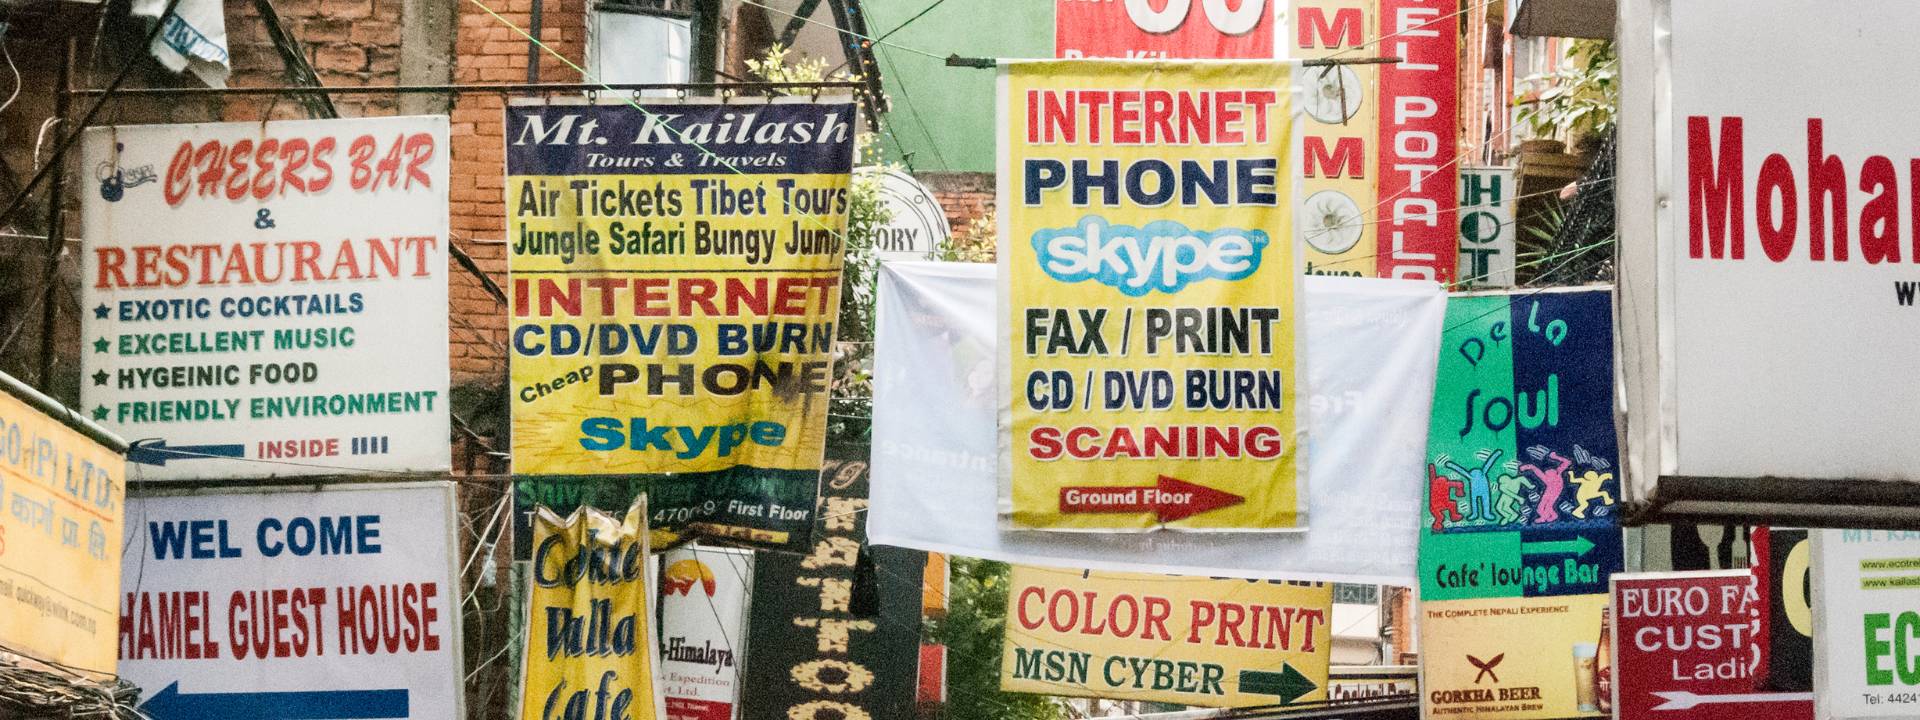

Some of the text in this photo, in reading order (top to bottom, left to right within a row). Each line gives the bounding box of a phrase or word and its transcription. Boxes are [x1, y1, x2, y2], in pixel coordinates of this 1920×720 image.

[1395, 3, 1440, 71] EL
[513, 111, 848, 146] Mt. Kailash
[1027, 89, 1277, 144] INTERNET
[163, 136, 337, 206] CHEERS
[348, 132, 435, 191] BAR
[586, 151, 787, 168] Tours & Travels
[517, 178, 848, 217] Air Tickets Tibet Tours
[1024, 158, 1278, 206] PHONE
[254, 208, 276, 229] &
[94, 236, 437, 289] RESTAURANT
[513, 221, 600, 264] Jungle
[609, 221, 686, 256] Safari
[694, 220, 777, 266] Bungy
[1047, 221, 1257, 288] skype
[118, 293, 365, 321] EXOTIC COCKTAILS
[513, 277, 840, 318] INTERNET
[118, 327, 356, 356] EXCELLENT MUSIC
[513, 321, 834, 357] CD/DVD BURN
[1025, 307, 1279, 355] FAX / PRINT
[118, 362, 319, 389] HYGEINIC FOOD
[518, 361, 829, 404] Cheap PHONE
[1025, 370, 1075, 410] CD
[1104, 370, 1175, 410] DVD
[1185, 369, 1282, 410] BURN
[118, 391, 438, 424] FRIENDLY ENVIRONMENT
[258, 438, 340, 459] INSIDE
[579, 416, 787, 460] Skype
[1029, 426, 1282, 459] SCANING
[727, 500, 765, 518] First
[769, 502, 811, 522] Floor
[1065, 488, 1194, 505] Ground Floor
[149, 515, 383, 560] WEL COME
[1491, 562, 1560, 592] lounge
[1564, 558, 1599, 583] Bar
[228, 587, 327, 661] GUEST
[337, 582, 440, 656] HOUSE
[1017, 586, 1325, 654] COLOR PRINT
[1622, 586, 1710, 618] EURO
[1012, 647, 1225, 696] MSN CYBER
[1430, 687, 1542, 704] GORKHA BEER
[1863, 692, 1884, 705] Tel:
